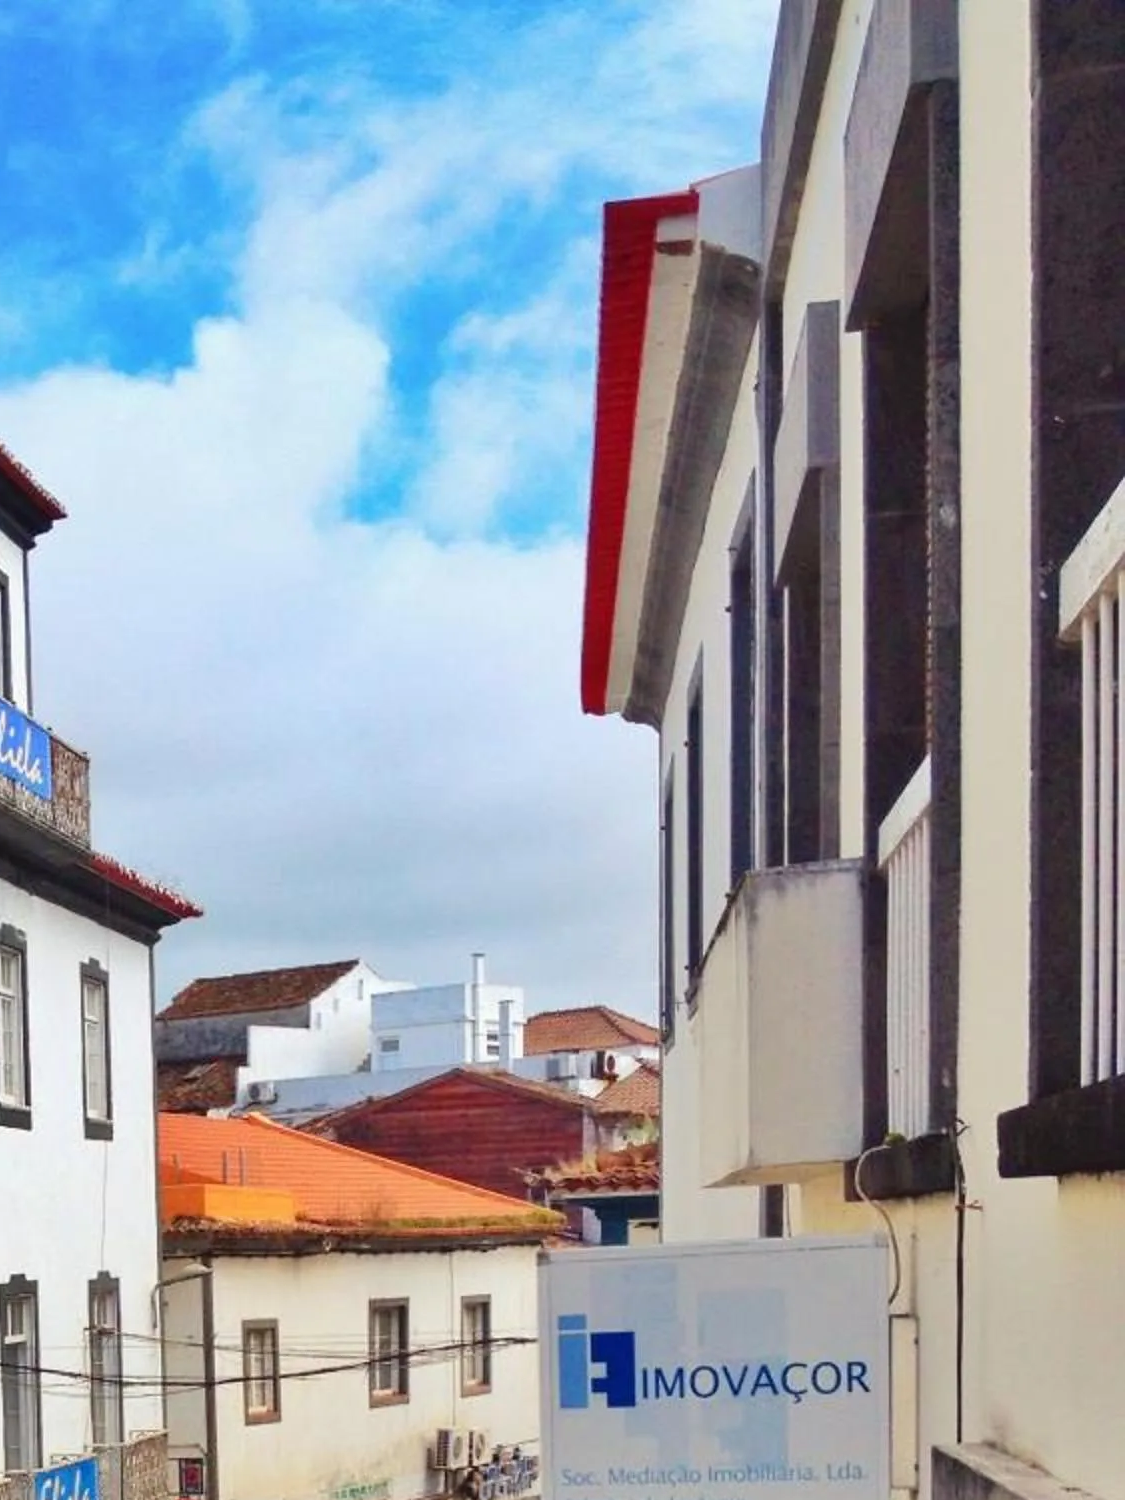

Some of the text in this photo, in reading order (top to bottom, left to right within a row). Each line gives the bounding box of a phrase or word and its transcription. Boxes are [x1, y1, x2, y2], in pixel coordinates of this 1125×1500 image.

[641, 1361, 871, 1404] IMOVAÇOR
[561, 1468, 601, 1487] Soc.
[608, 1464, 702, 1488] Mediação
[827, 1461, 869, 1481] Lda.
